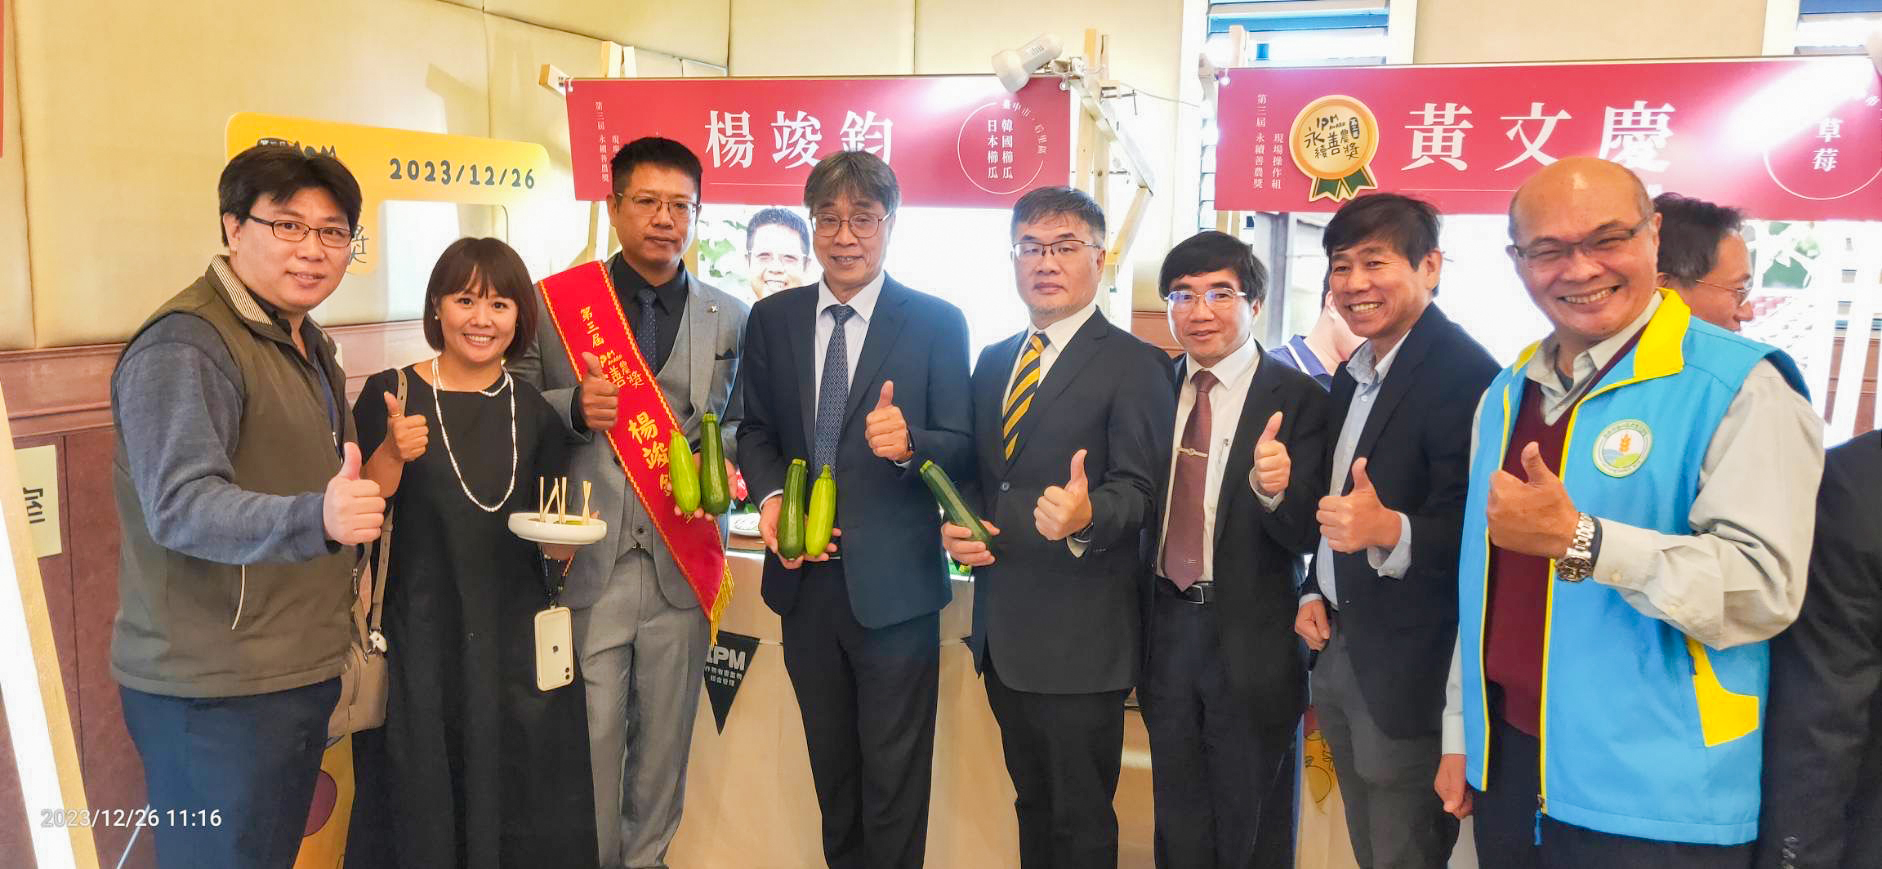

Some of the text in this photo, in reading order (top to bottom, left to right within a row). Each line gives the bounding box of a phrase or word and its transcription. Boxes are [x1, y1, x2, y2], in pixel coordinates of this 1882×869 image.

[1256, 94, 1267, 128] 第三屆
[1316, 113, 1339, 131] IPM
[704, 110, 894, 169] 楊竣鈞
[1400, 100, 1676, 172] 黃文慶
[1812, 118, 1844, 172] 草莓
[389, 157, 536, 190] 2023/12/26
[1271, 133, 1284, 190] 現場操作組
[580, 306, 605, 348] 第三屆
[599, 350, 616, 368] PM
